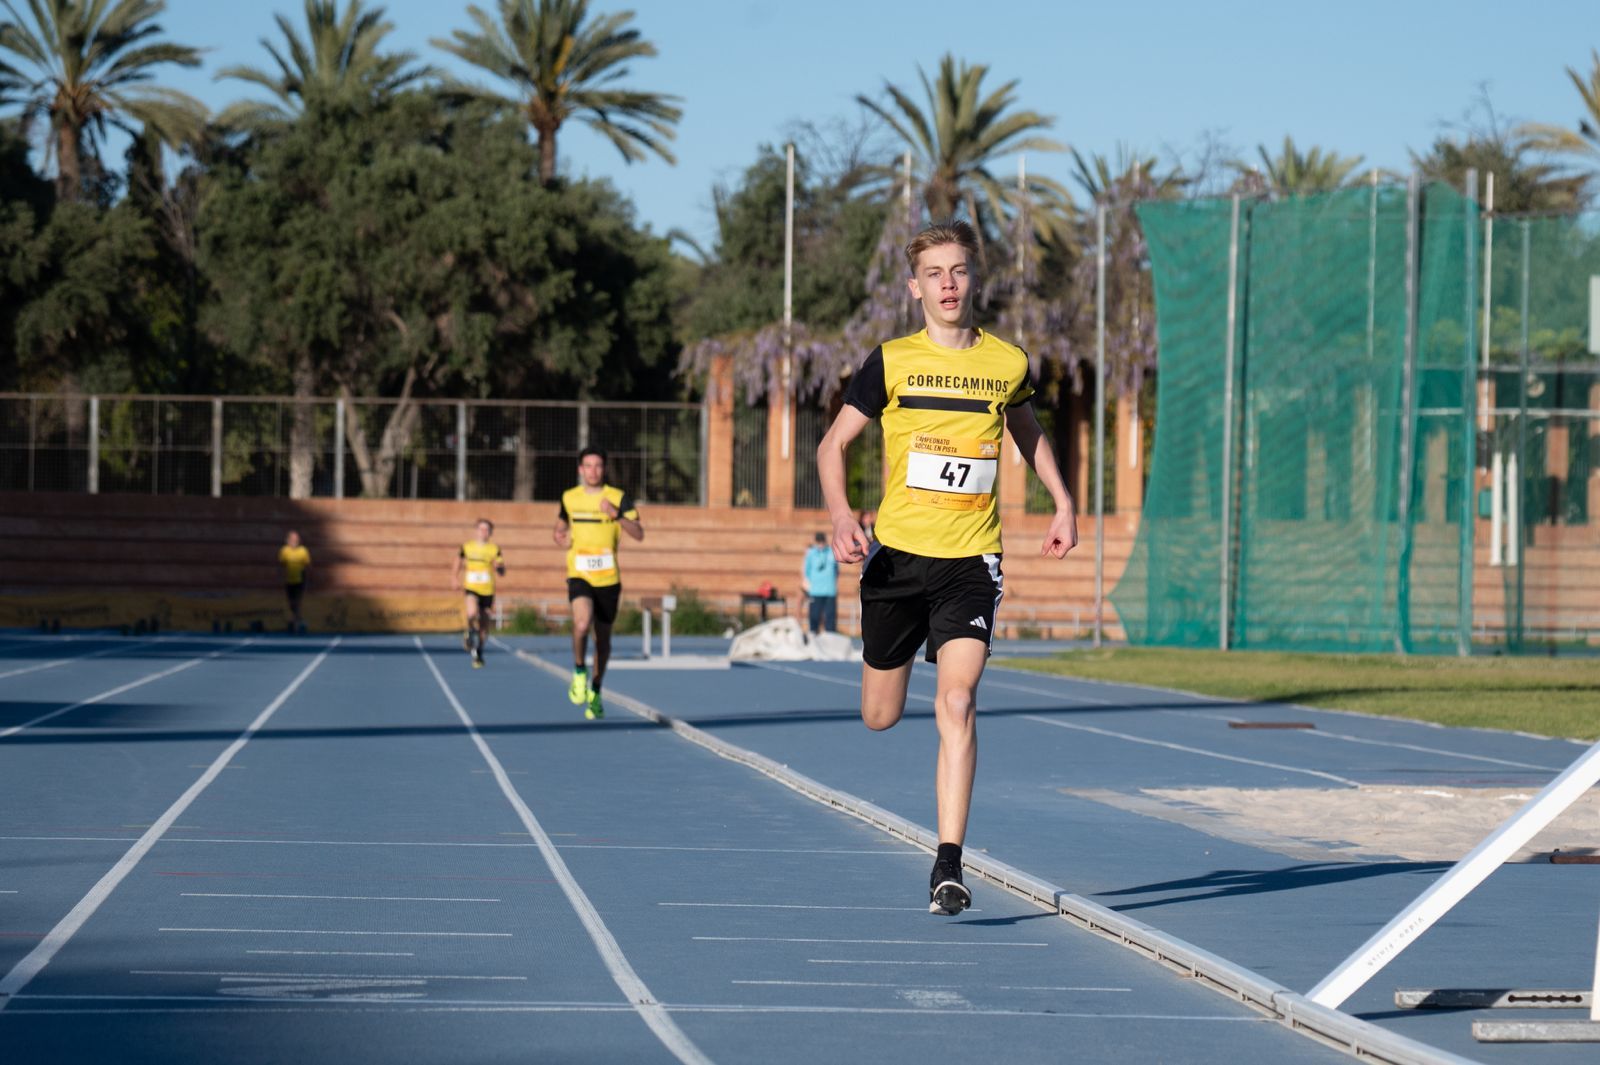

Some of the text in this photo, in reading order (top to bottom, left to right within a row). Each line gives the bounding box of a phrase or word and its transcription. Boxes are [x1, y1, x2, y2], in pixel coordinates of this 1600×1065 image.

[907, 374, 1009, 393] CORRECAMINOS
[915, 435, 950, 446] CAMPEONATO
[914, 443, 933, 451] SOCIAL
[939, 461, 971, 488] 47
[587, 558, 603, 568] 120
